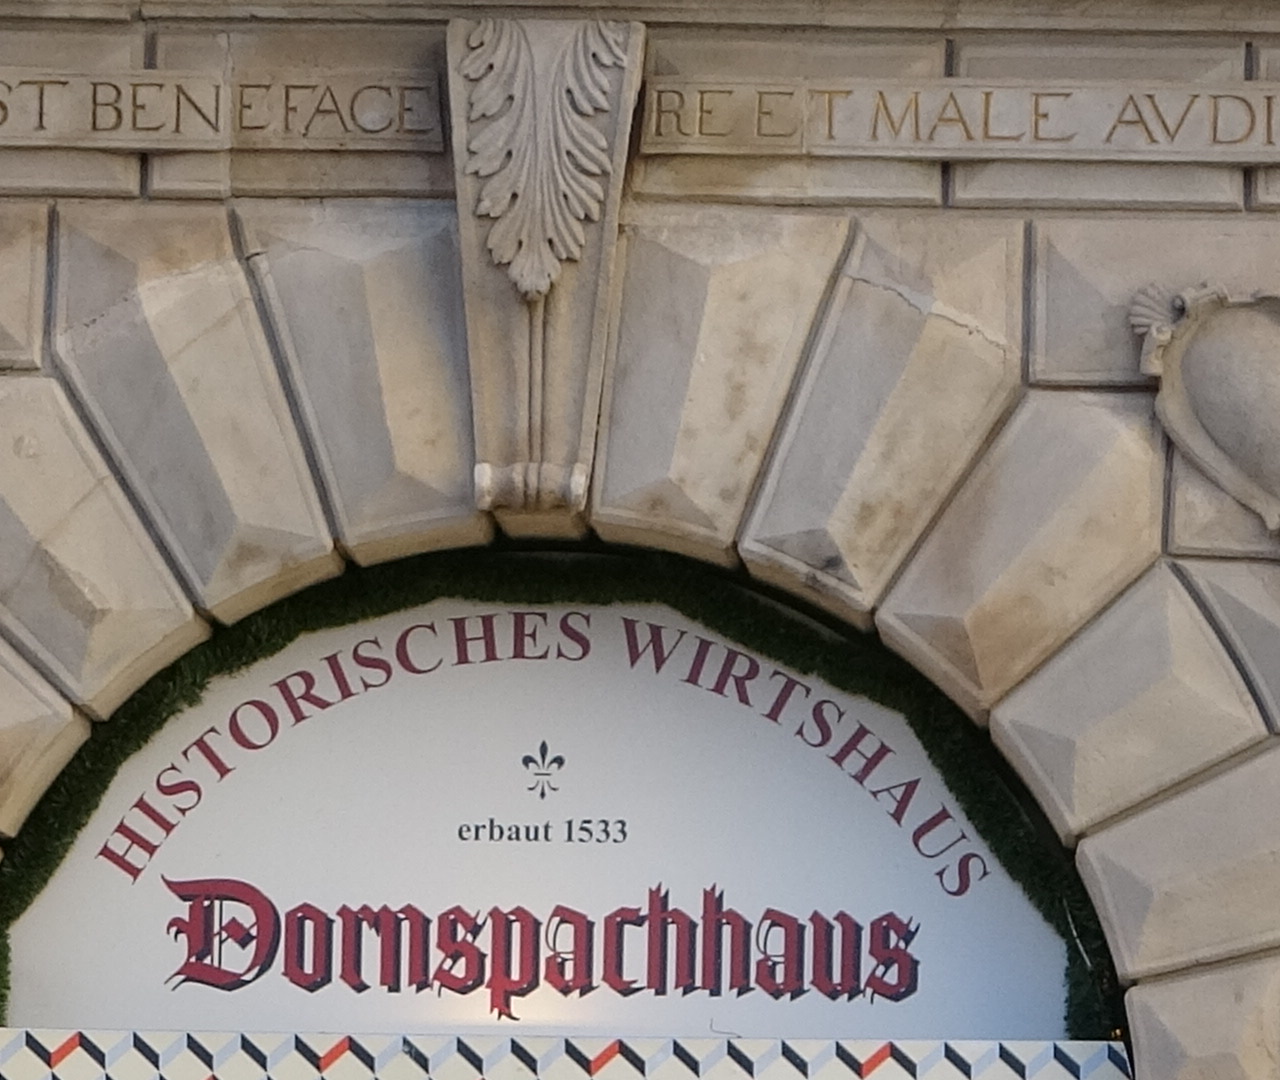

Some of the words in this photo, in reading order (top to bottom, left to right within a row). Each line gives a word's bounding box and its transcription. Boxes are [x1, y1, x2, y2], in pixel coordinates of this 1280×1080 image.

[869, 91, 1077, 144] MALE
[95, 611, 592, 884] HISTORISCHES
[621, 617, 991, 897] WIRTSHAUS
[457, 818, 552, 842] erbaut
[564, 819, 628, 843] 1533
[161, 874, 921, 1021] Dornspachhaus
